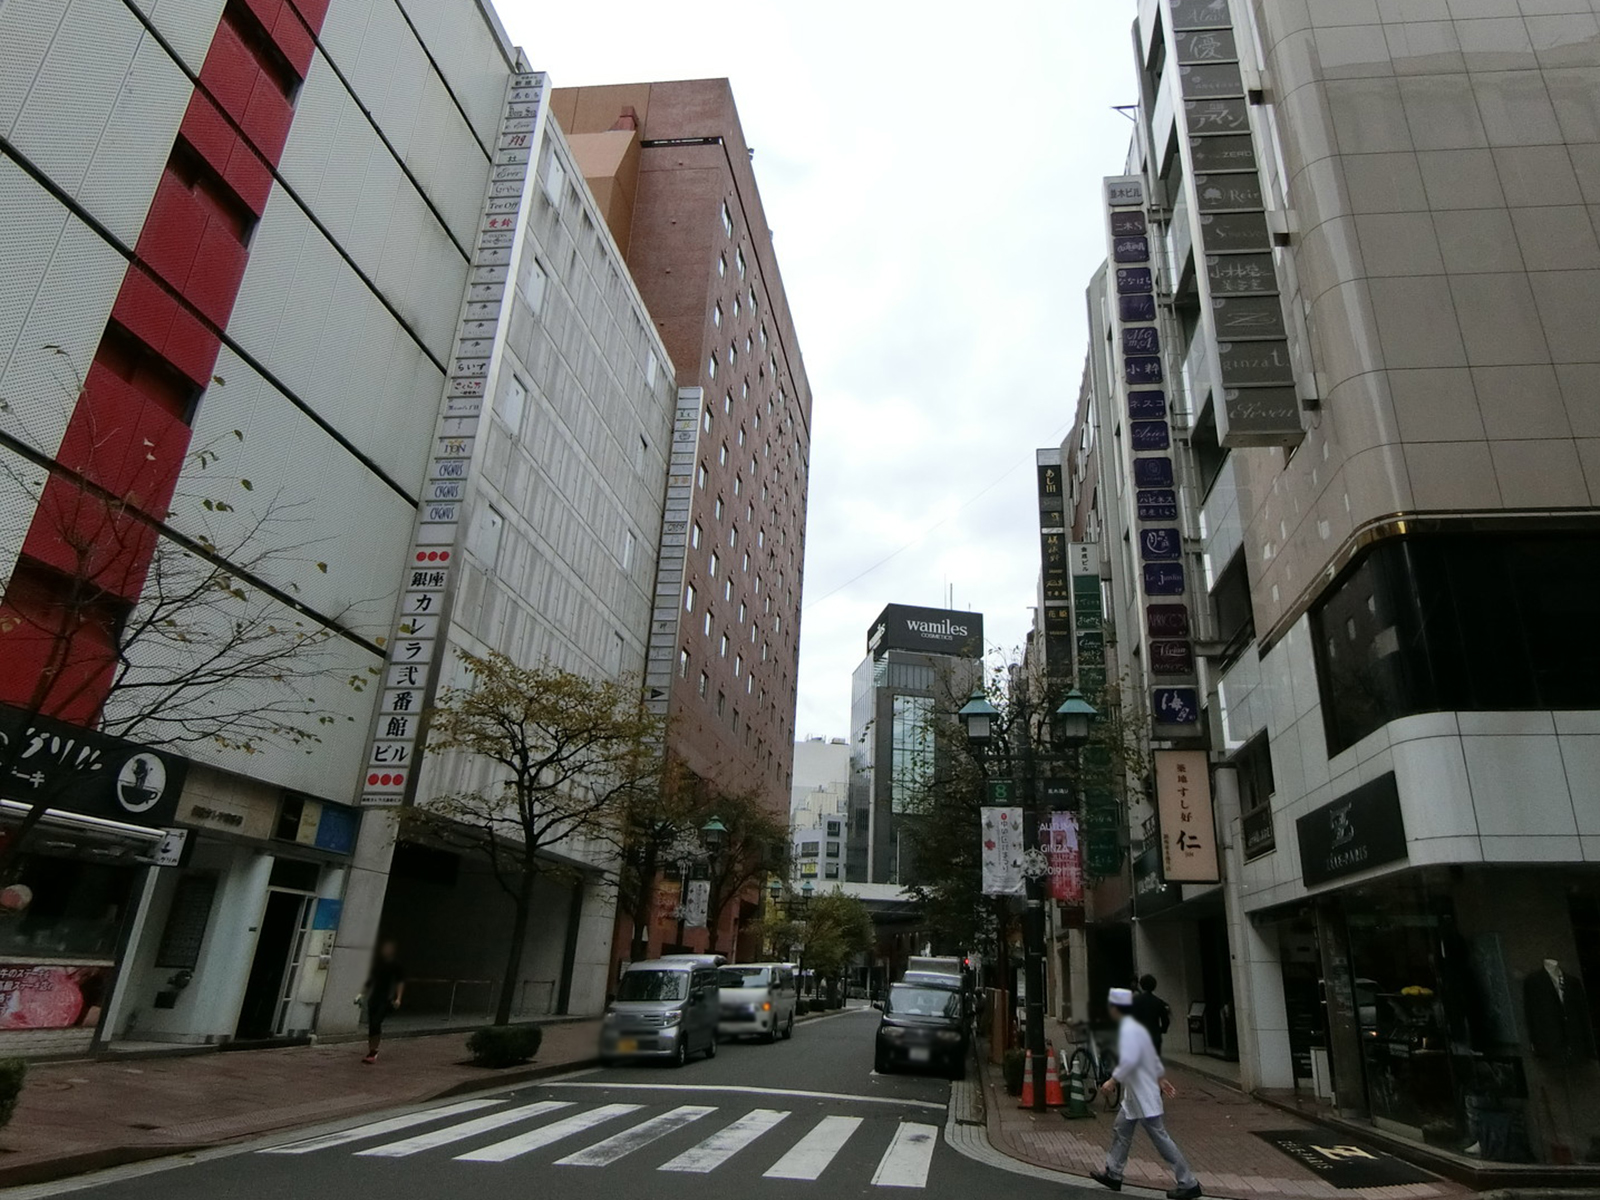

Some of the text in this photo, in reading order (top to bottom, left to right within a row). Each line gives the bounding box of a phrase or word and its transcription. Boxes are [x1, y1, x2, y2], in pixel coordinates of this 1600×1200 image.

[1189, 33, 1224, 59] 優
[906, 618, 968, 637] wamiles
[920, 632, 953, 641] COSMETICS
[995, 784, 1008, 799] 8
[1040, 843, 1070, 854] GINZA
[1176, 830, 1202, 852] 仁
